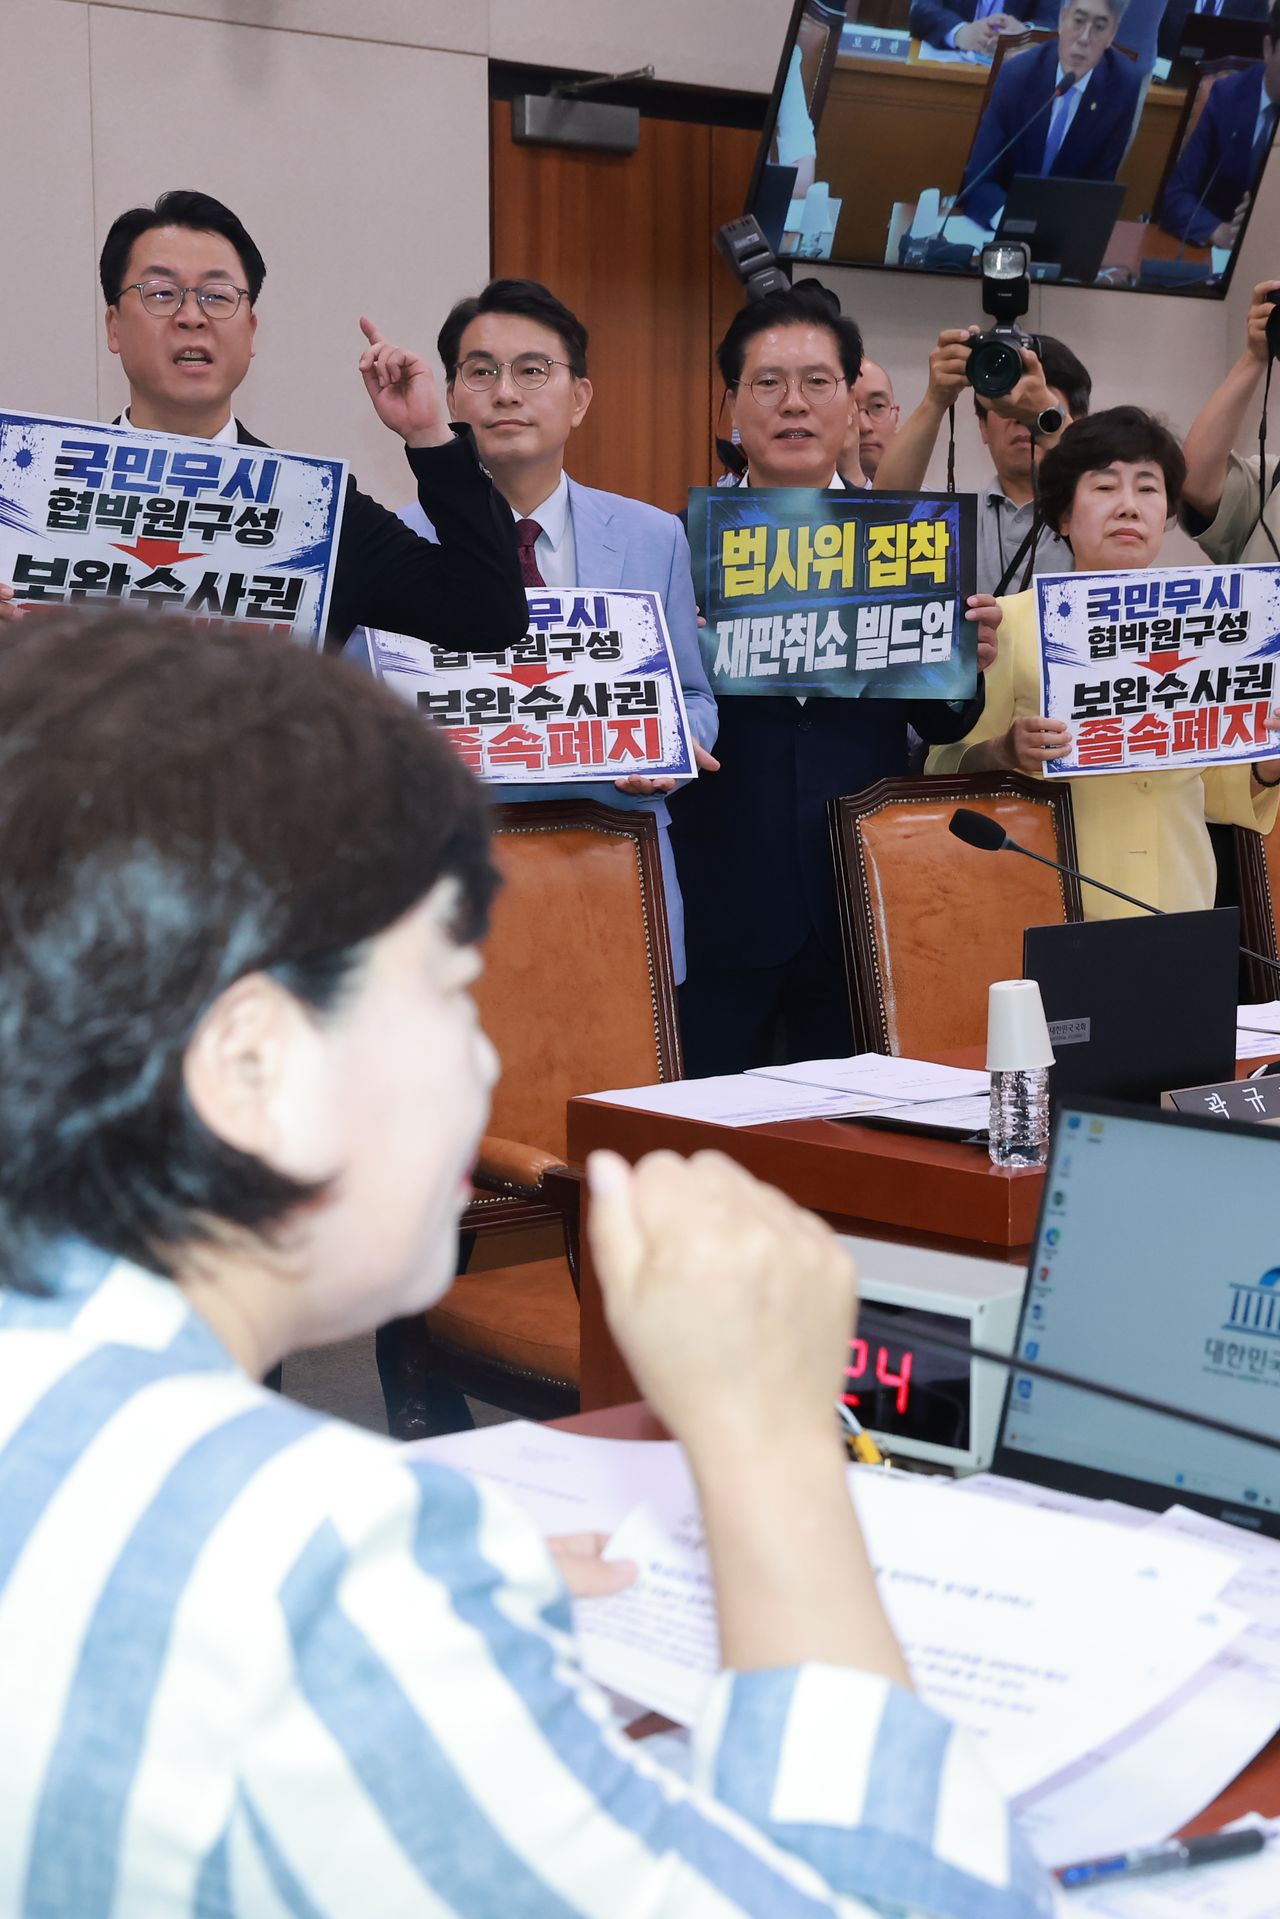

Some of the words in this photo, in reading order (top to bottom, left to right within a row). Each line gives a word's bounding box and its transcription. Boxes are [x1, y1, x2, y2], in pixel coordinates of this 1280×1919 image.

[54, 440, 280, 504] 국민무시
[46, 487, 280, 547] 협박원구성
[722, 521, 856, 598] 법사위
[867, 520, 950, 588] 집착
[1086, 574, 1242, 622] 국민무시
[712, 610, 849, 679] 재판취소
[855, 600, 956, 671] 빌드업
[1088, 611, 1249, 660] 협박원구성
[418, 680, 660, 726] 보완수사권
[1071, 662, 1274, 720] 보완수사권
[1076, 701, 1270, 766] 졸속폐지
